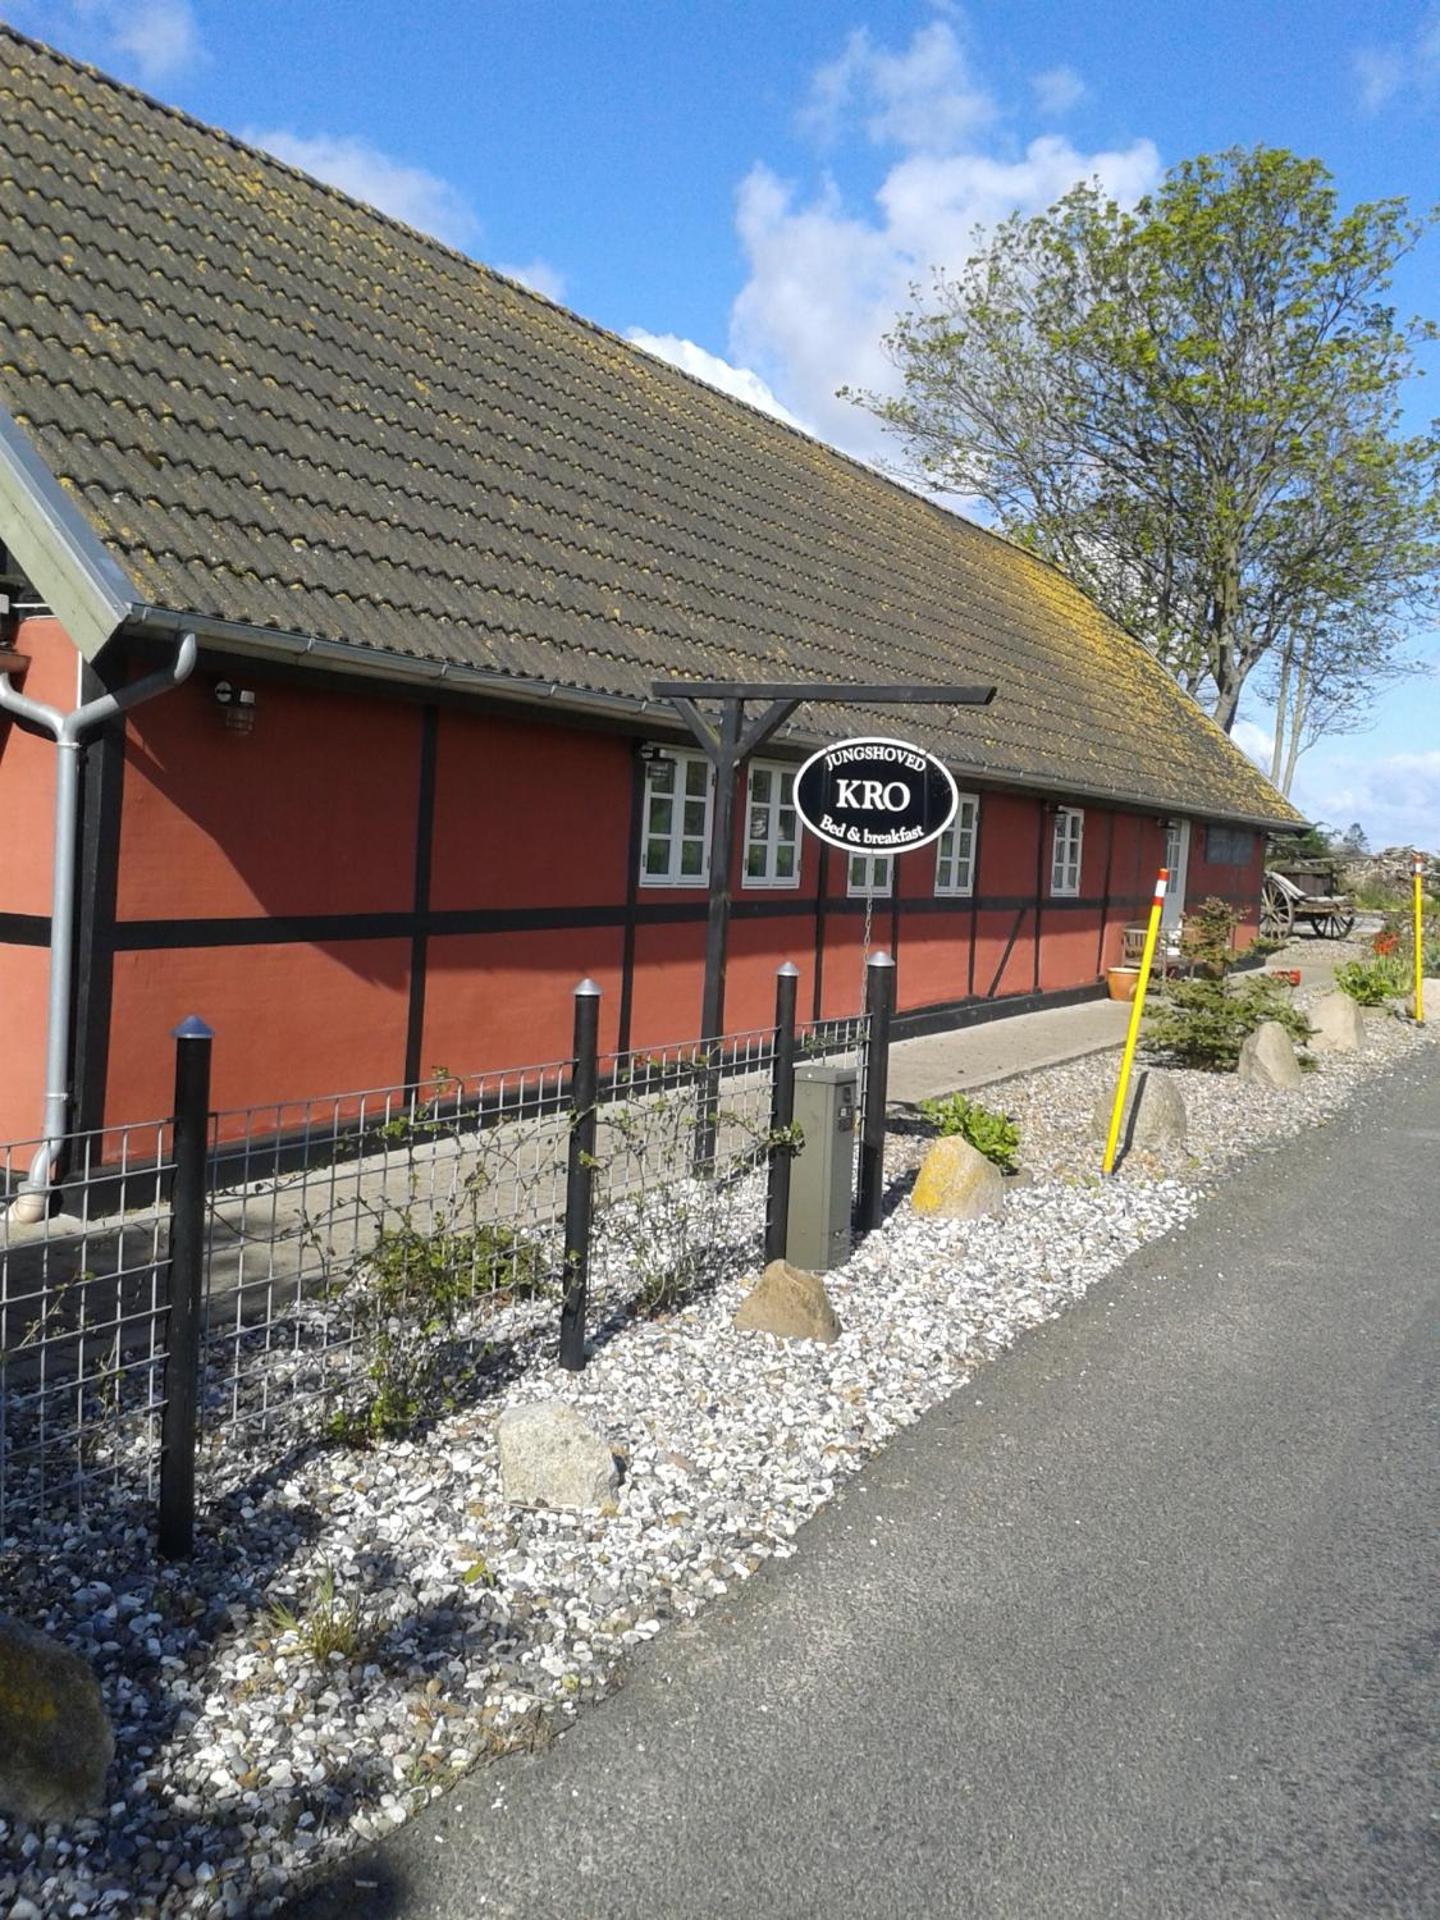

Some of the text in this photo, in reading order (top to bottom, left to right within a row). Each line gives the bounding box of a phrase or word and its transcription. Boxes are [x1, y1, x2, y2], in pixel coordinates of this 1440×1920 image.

[825, 746, 926, 771] JUNGSHOVED
[836, 779, 911, 812] KRO
[820, 814, 924, 845] Bed & breakfast
